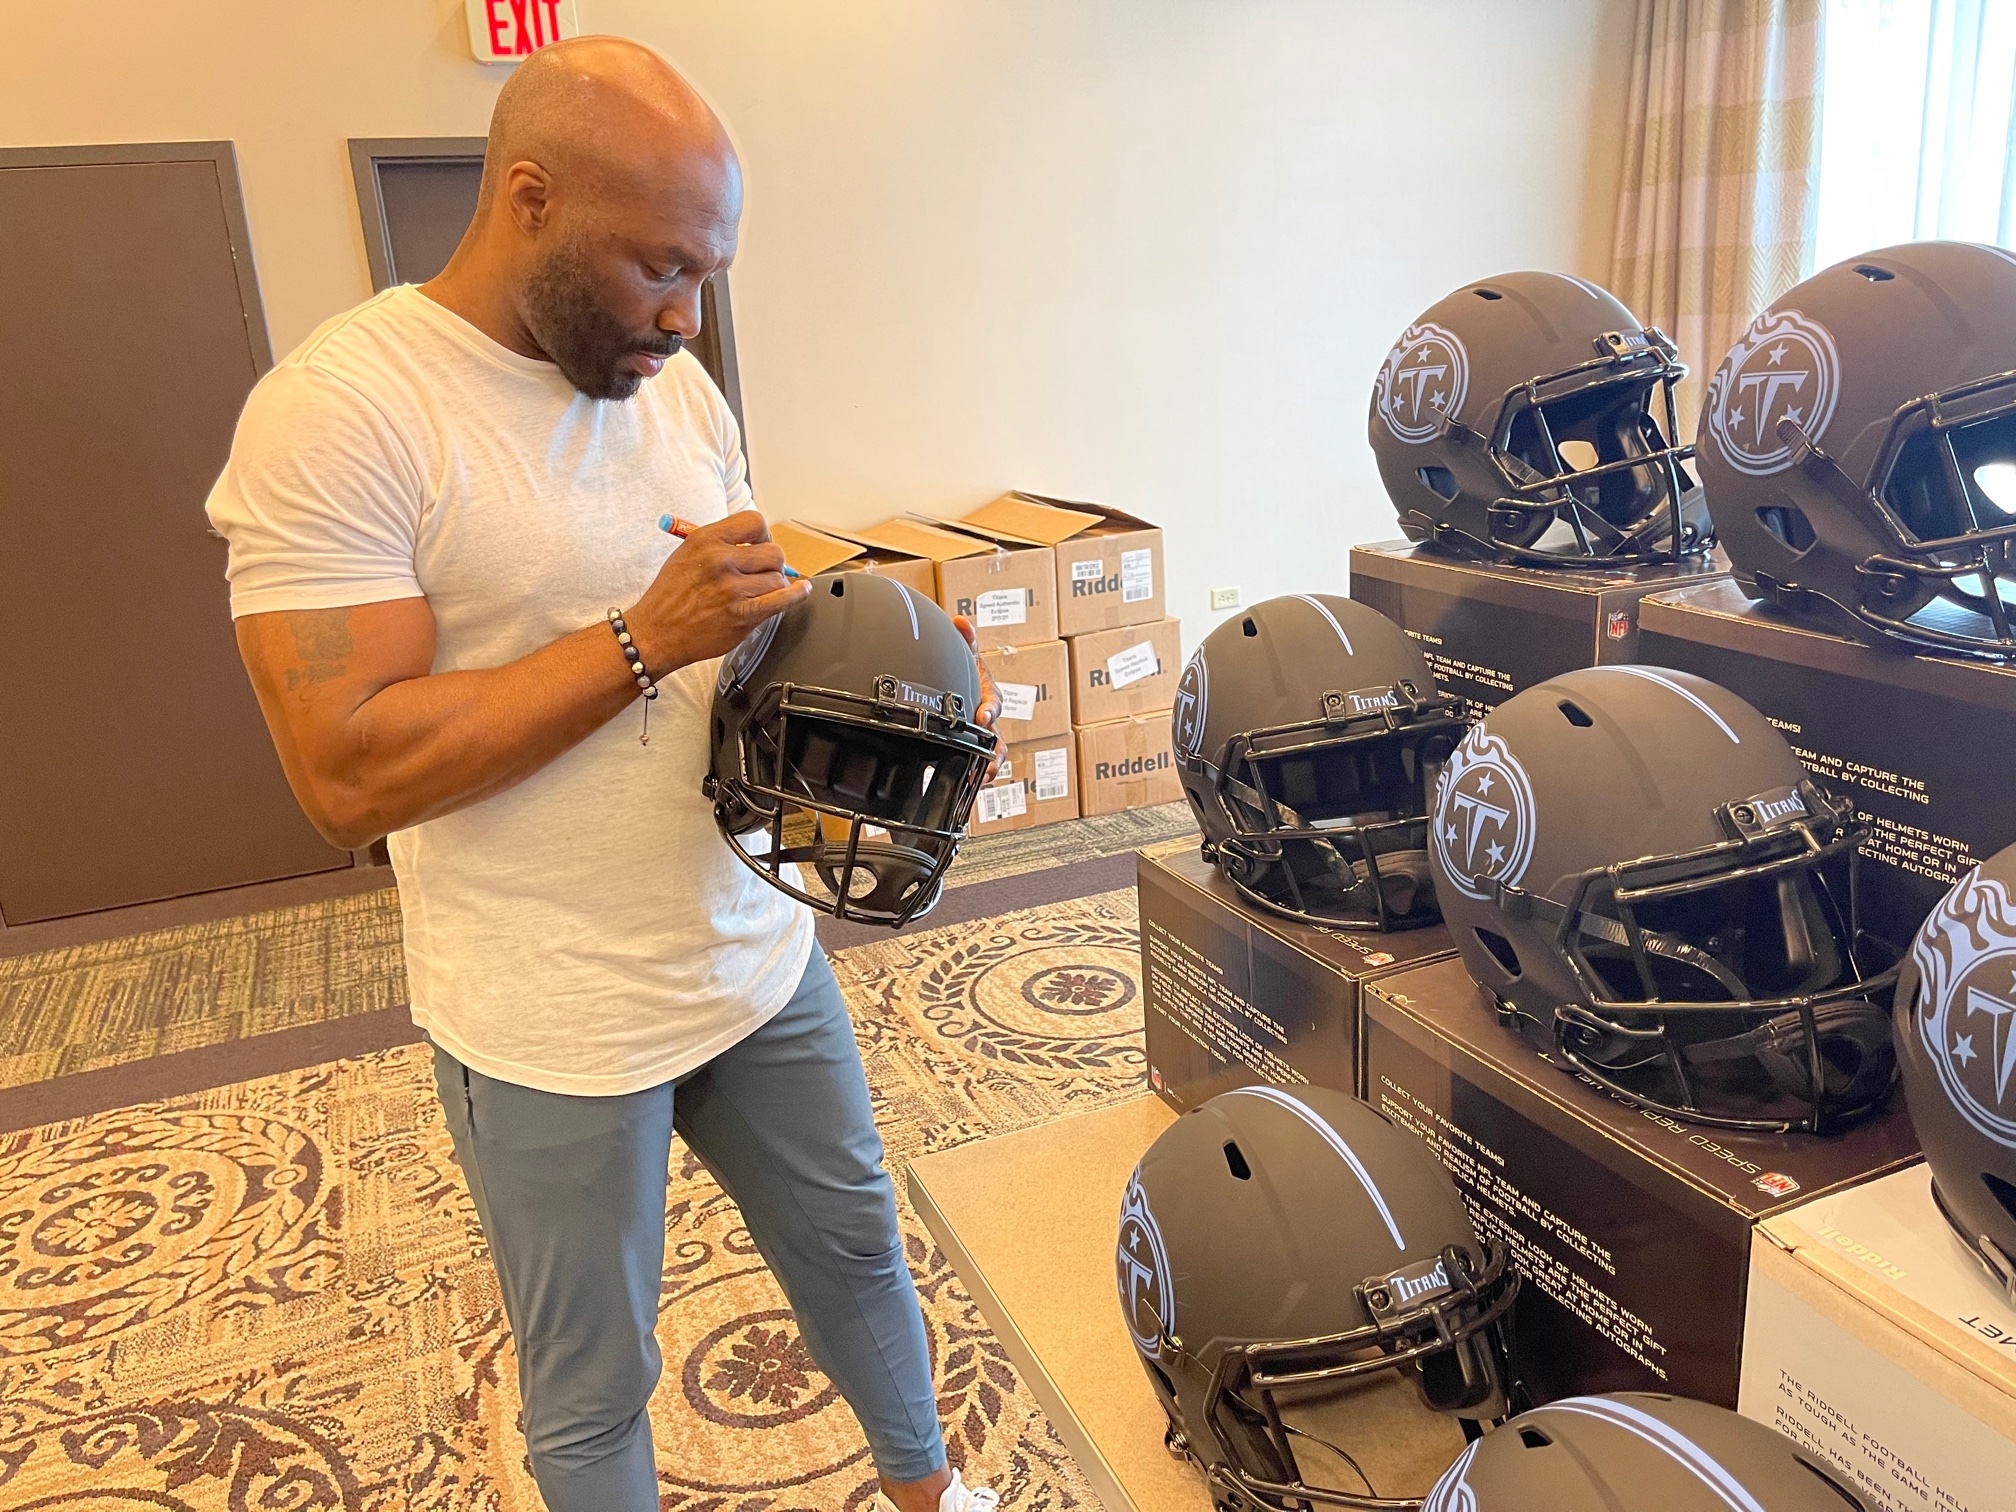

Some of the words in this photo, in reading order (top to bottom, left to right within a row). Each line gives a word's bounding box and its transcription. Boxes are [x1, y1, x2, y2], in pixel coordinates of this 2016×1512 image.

[486, 0, 562, 55] EXIT
[1434, 663, 1463, 678] FOOTBALL
[1475, 675, 1514, 692] COLLECTING
[1467, 664, 1495, 677] CAPTURE
[1497, 672, 1510, 682] THE
[1820, 755, 1842, 768] AND
[1846, 762, 1898, 783] CAPTURE
[1902, 776, 1925, 790] THE
[1842, 772, 1857, 783] BY
[1860, 777, 1929, 804] COLLECTING
[1858, 812, 1872, 822] OF
[1877, 816, 1929, 840] HELMETS
[1932, 834, 1968, 852] WORN
[1858, 846, 1898, 866] ECTING
[1874, 828, 1896, 842] THE
[1900, 837, 1954, 859] PERFECT
[1886, 844, 1918, 861] HOME
[1922, 854, 1938, 867] OR
[1945, 862, 1956, 873] IN
[1381, 1075, 1410, 1100] COLLECT
[1412, 1098, 1434, 1117] YOUR
[1436, 1114, 1472, 1144] FAVORITE
[1381, 1094, 1414, 1120] SUPPORT
[1415, 1118, 1436, 1138] YOUR
[1438, 1136, 1475, 1166] FAVORITE
[1478, 1163, 1493, 1180] NFL
[1496, 1176, 1519, 1197] TEAM
[1522, 1195, 1541, 1212] AND
[1544, 1210, 1588, 1245] CAPTURE
[1591, 1242, 1612, 1261] THE
[1689, 1134, 1762, 1174] SPEED
[1381, 1104, 1424, 1138] EXCITEMENT
[1426, 1137, 1441, 1151] AND
[1444, 1149, 1476, 1178] REALISM
[1479, 1175, 1490, 1186] OF
[1493, 1185, 1538, 1221] FOOTBALL
[1540, 1218, 1553, 1231] BY
[1556, 1230, 1616, 1276] COLLECTING
[1443, 1158, 1474, 1186] REPLICA
[1477, 1183, 1516, 1217] HELMETS.
[1465, 1194, 1480, 1210] THE
[1483, 1208, 1525, 1244] EXTERIOR
[1528, 1241, 1552, 1264] LOOK
[1556, 1261, 1569, 1274] OF
[1573, 1273, 1617, 1310] HELMETS
[1621, 1307, 1652, 1335] WORN
[1469, 1208, 1502, 1237] REPLICA
[1506, 1234, 1544, 1268] HELMETS
[1548, 1267, 1567, 1285] ARE
[1570, 1284, 1590, 1302] THE
[1593, 1299, 1638, 1336] PERFECT
[1643, 1335, 1667, 1355] GIFT
[1510, 1249, 1529, 1268] OOK
[1532, 1266, 1562, 1292] GREAT
[1566, 1289, 1578, 1302] AT
[1581, 1298, 1610, 1327] HOME
[1614, 1325, 1628, 1341] OR
[1632, 1337, 1642, 1351] IN
[1515, 1262, 1532, 1281] FOR
[1536, 1279, 1592, 1325] COLLECTING
[1596, 1323, 1668, 1381] AUTOGRAPHS.
[1775, 1419, 1797, 1441] FOR
[1776, 1406, 1824, 1450] RIDDELL
[1830, 1448, 1851, 1470] HAS
[1857, 1470, 1891, 1500] BEEN
[1778, 1383, 1793, 1397] AS
[1798, 1396, 1836, 1432] TOUGH
[1842, 1432, 1856, 1446] AS
[1862, 1445, 1885, 1469] THE
[1891, 1467, 1928, 1500] GAME
[1780, 1369, 1802, 1393] THE
[1808, 1389, 1857, 1434] RIDDELL
[1863, 1433, 1929, 1488] FOOTBALL
